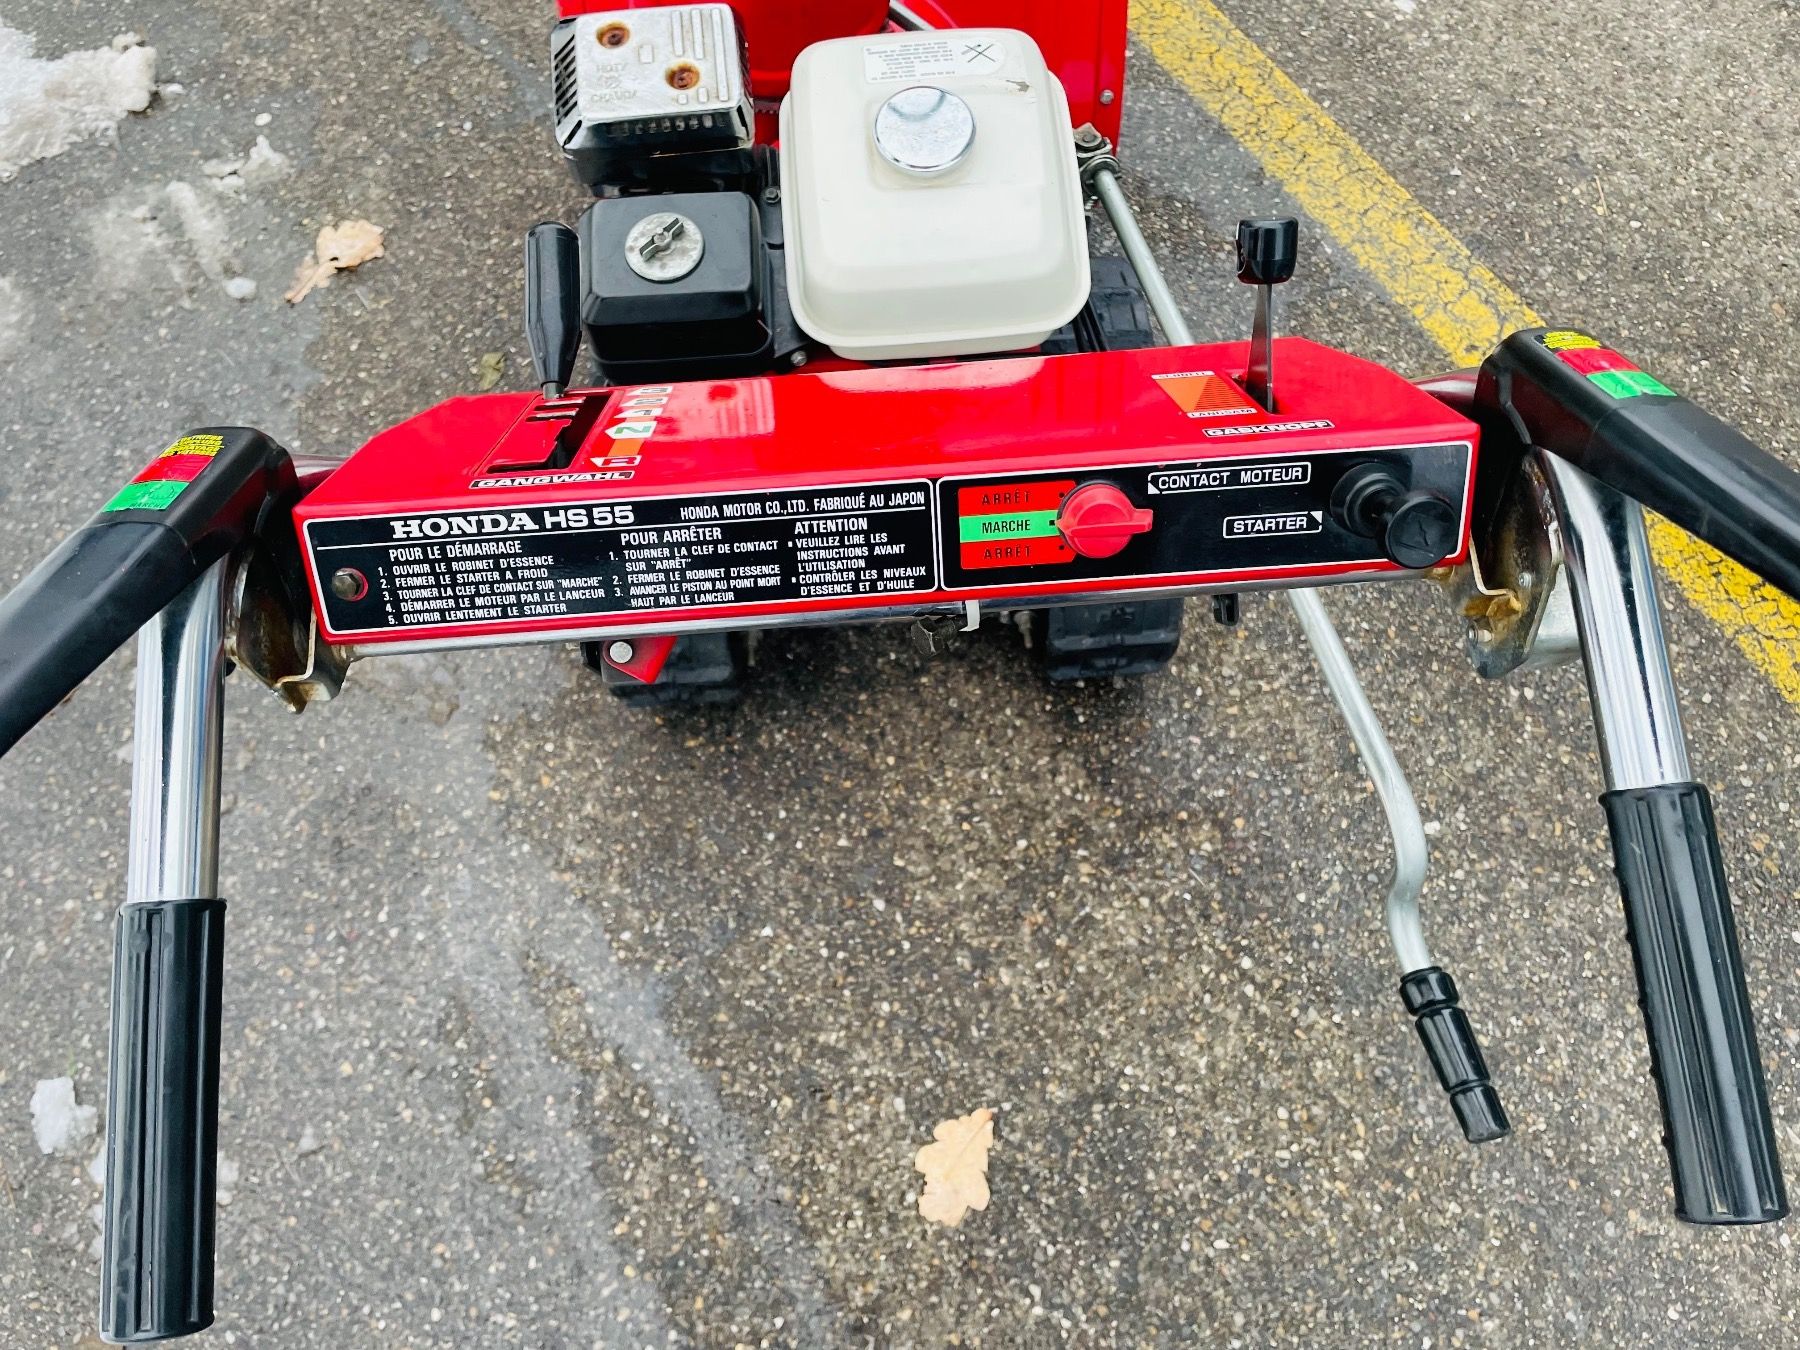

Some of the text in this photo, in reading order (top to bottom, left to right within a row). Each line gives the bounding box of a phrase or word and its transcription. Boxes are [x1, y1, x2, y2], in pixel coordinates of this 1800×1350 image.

[614, 426, 652, 434] N
[1207, 421, 1328, 436] GASKNOPF
[602, 456, 637, 466] R
[478, 472, 626, 488] GANGWAHL
[1158, 467, 1303, 490] CONTACT MOTEUR
[680, 505, 720, 520] HONDA
[722, 502, 762, 518] MOTOR
[814, 492, 866, 512] FABRIQUÉ
[869, 494, 885, 508] AU
[888, 491, 925, 506] JAPON
[389, 512, 540, 539] HONDA
[794, 518, 868, 534] ATTENTION
[982, 519, 1031, 534] MARCHE
[1233, 516, 1308, 533] STARTER
[620, 526, 722, 546] POUR ARRÊTER
[796, 532, 888, 548] VEUILLEZ LIRE LES
[389, 540, 522, 562] POUR LE DÉMARRAGE
[608, 540, 778, 560] 1. TOURNER LA CLEF DE CONTACT
[797, 544, 906, 560] INSTRUCTIONS AVANT
[378, 556, 554, 576] 1. OUVRIR LE ROBINET D'ESSENCE
[625, 562, 646, 572] SUR
[798, 558, 866, 572] L'UTILISATION
[380, 568, 548, 589] 2. FERMER LE STARTER A FROID
[612, 564, 780, 585] 2. FERMER LE ROBINET D'ESSENCE
[800, 566, 926, 584] CONTRÔLER LES NIVEAUX
[382, 576, 602, 601] 3. TOURNER LA CLEF DE CONTACT SUR "MARCHE"
[614, 576, 781, 597] 3. AVANCER LE PISTON AU POINT MORT
[800, 579, 915, 596] D'ESSENCE ET D'HUILE
[386, 588, 606, 613] 4. DÉMARRER LE MOTEUR PAR LE LANCEUR
[630, 592, 735, 608] HAUT PAR LE LANCEUR
[388, 602, 567, 624] 5. OUVRIR LENTEMENT LE STARTER
